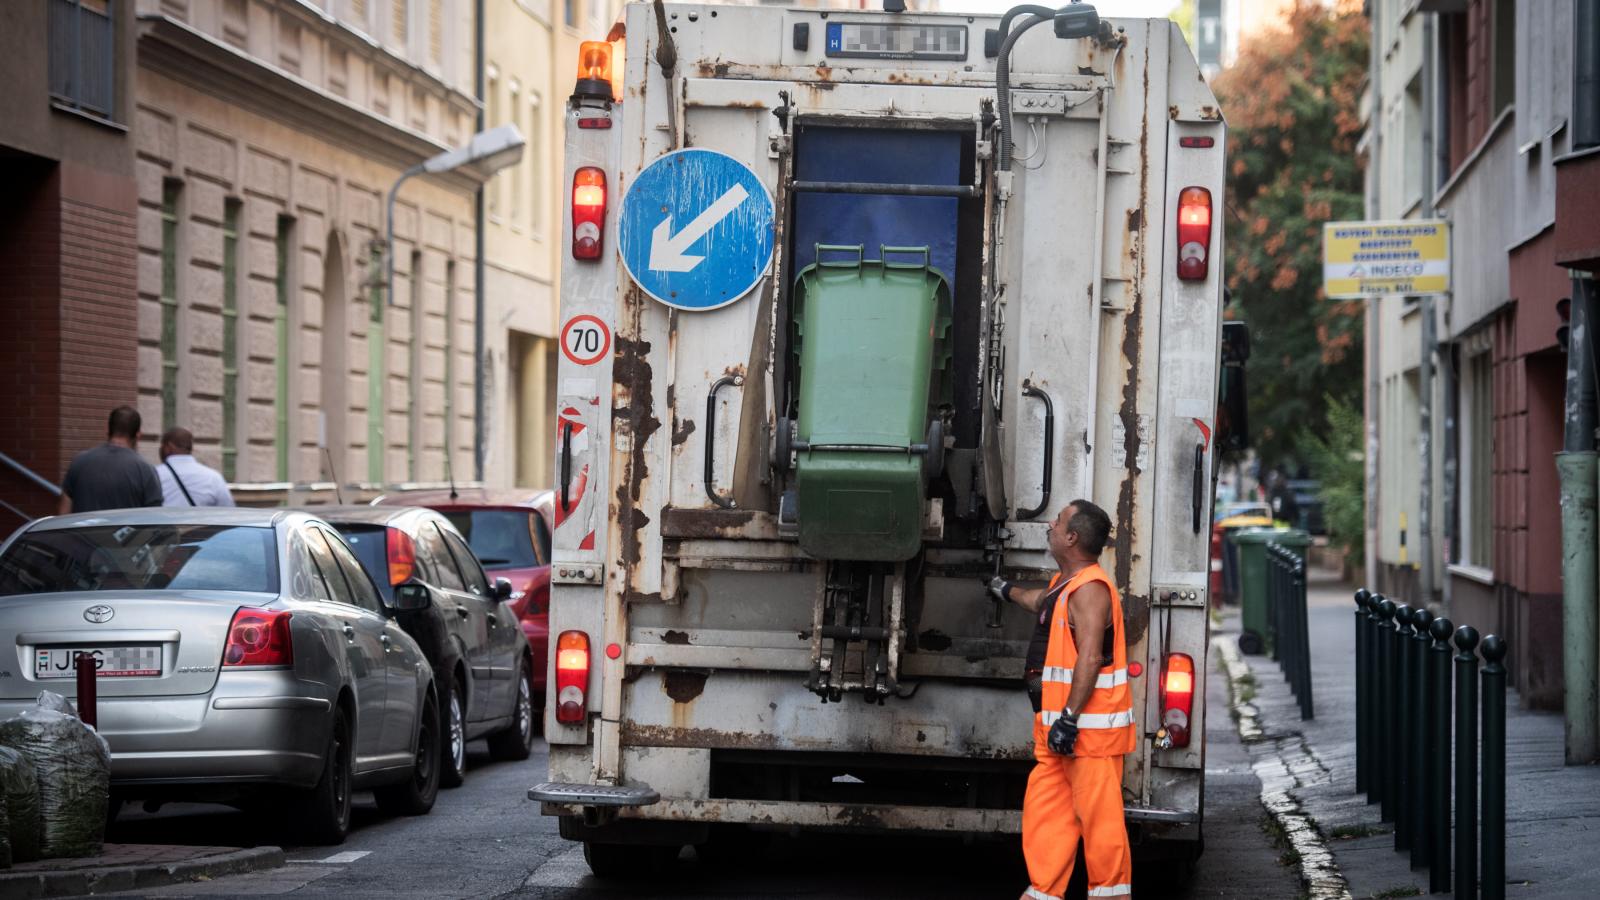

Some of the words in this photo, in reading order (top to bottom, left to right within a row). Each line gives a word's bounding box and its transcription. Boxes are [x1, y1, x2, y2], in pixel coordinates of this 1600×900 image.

[831, 40, 838, 48] H
[1371, 262, 1424, 276] INDECO
[573, 328, 599, 353] 70
[38, 661, 48, 671] H
